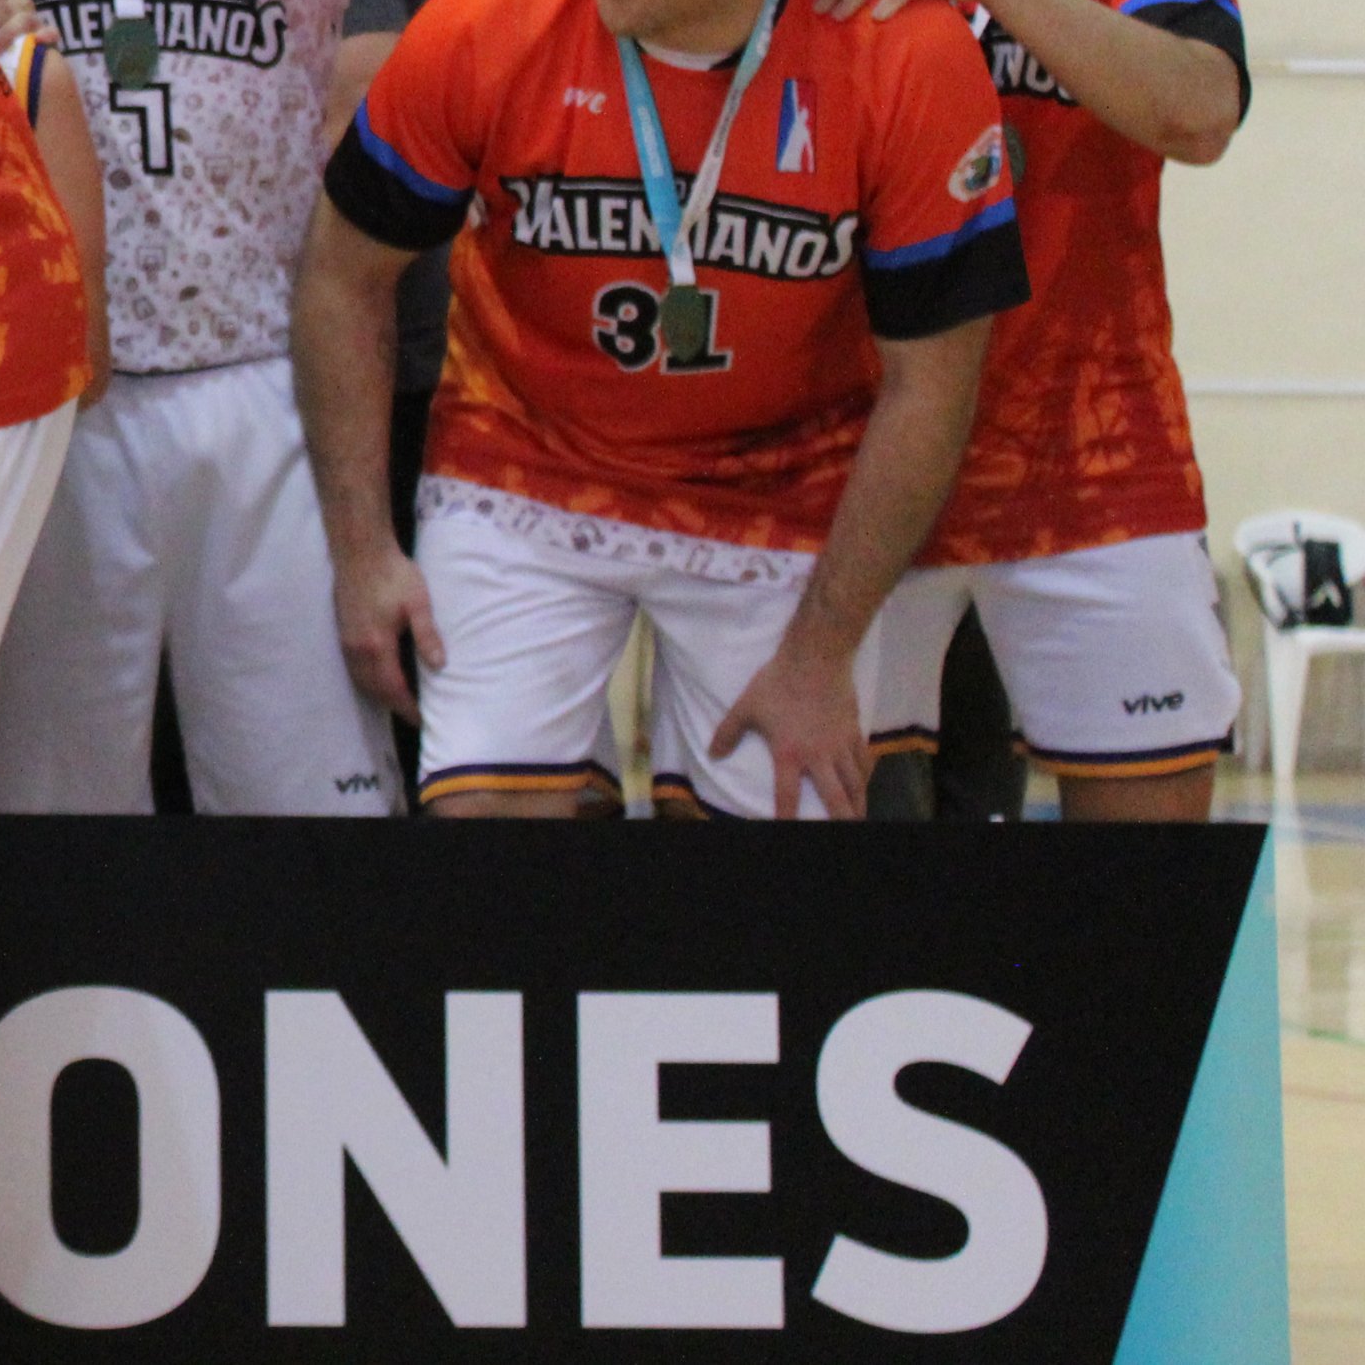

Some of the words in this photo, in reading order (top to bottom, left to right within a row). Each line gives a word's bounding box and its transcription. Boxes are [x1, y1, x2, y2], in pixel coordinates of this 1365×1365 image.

[35, 0, 287, 67] ALEIANOS
[110, 83, 174, 176] 7
[507, 179, 859, 279] VALENIANOS
[1122, 691, 1184, 714] vive
